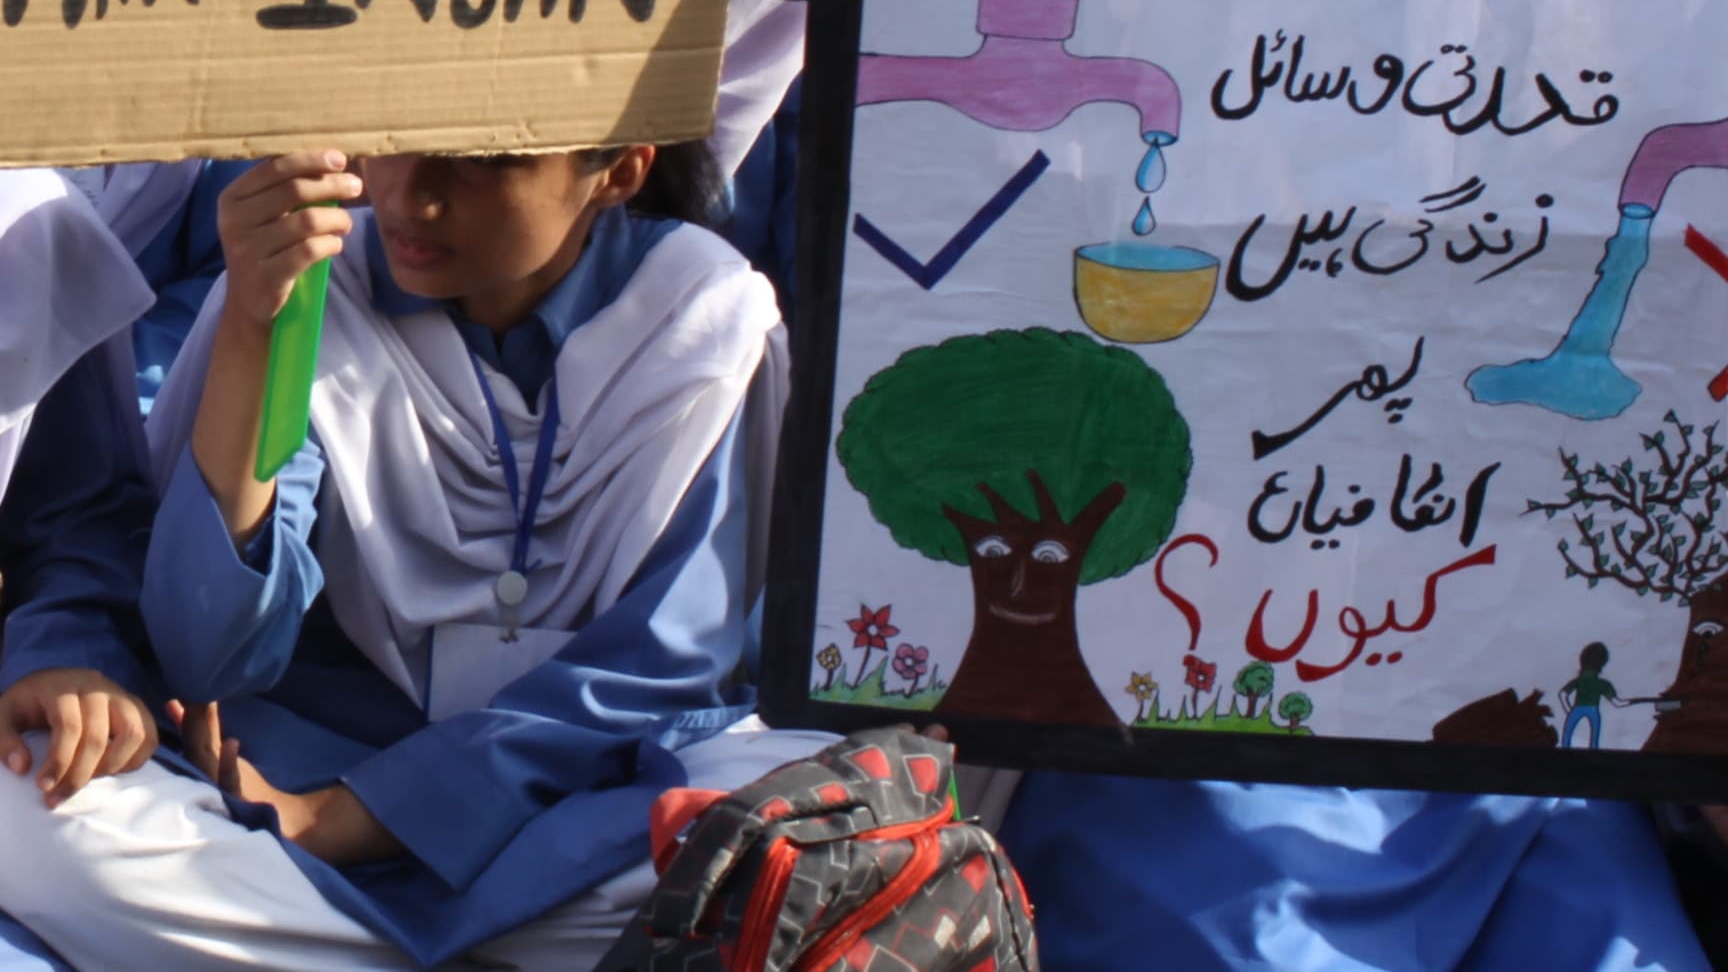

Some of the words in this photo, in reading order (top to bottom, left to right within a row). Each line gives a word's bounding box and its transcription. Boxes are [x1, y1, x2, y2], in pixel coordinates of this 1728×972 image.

[1225, 206, 1357, 301] ہیں
[1351, 176, 1555, 285] زندگی
[1250, 335, 1425, 461] پھر
